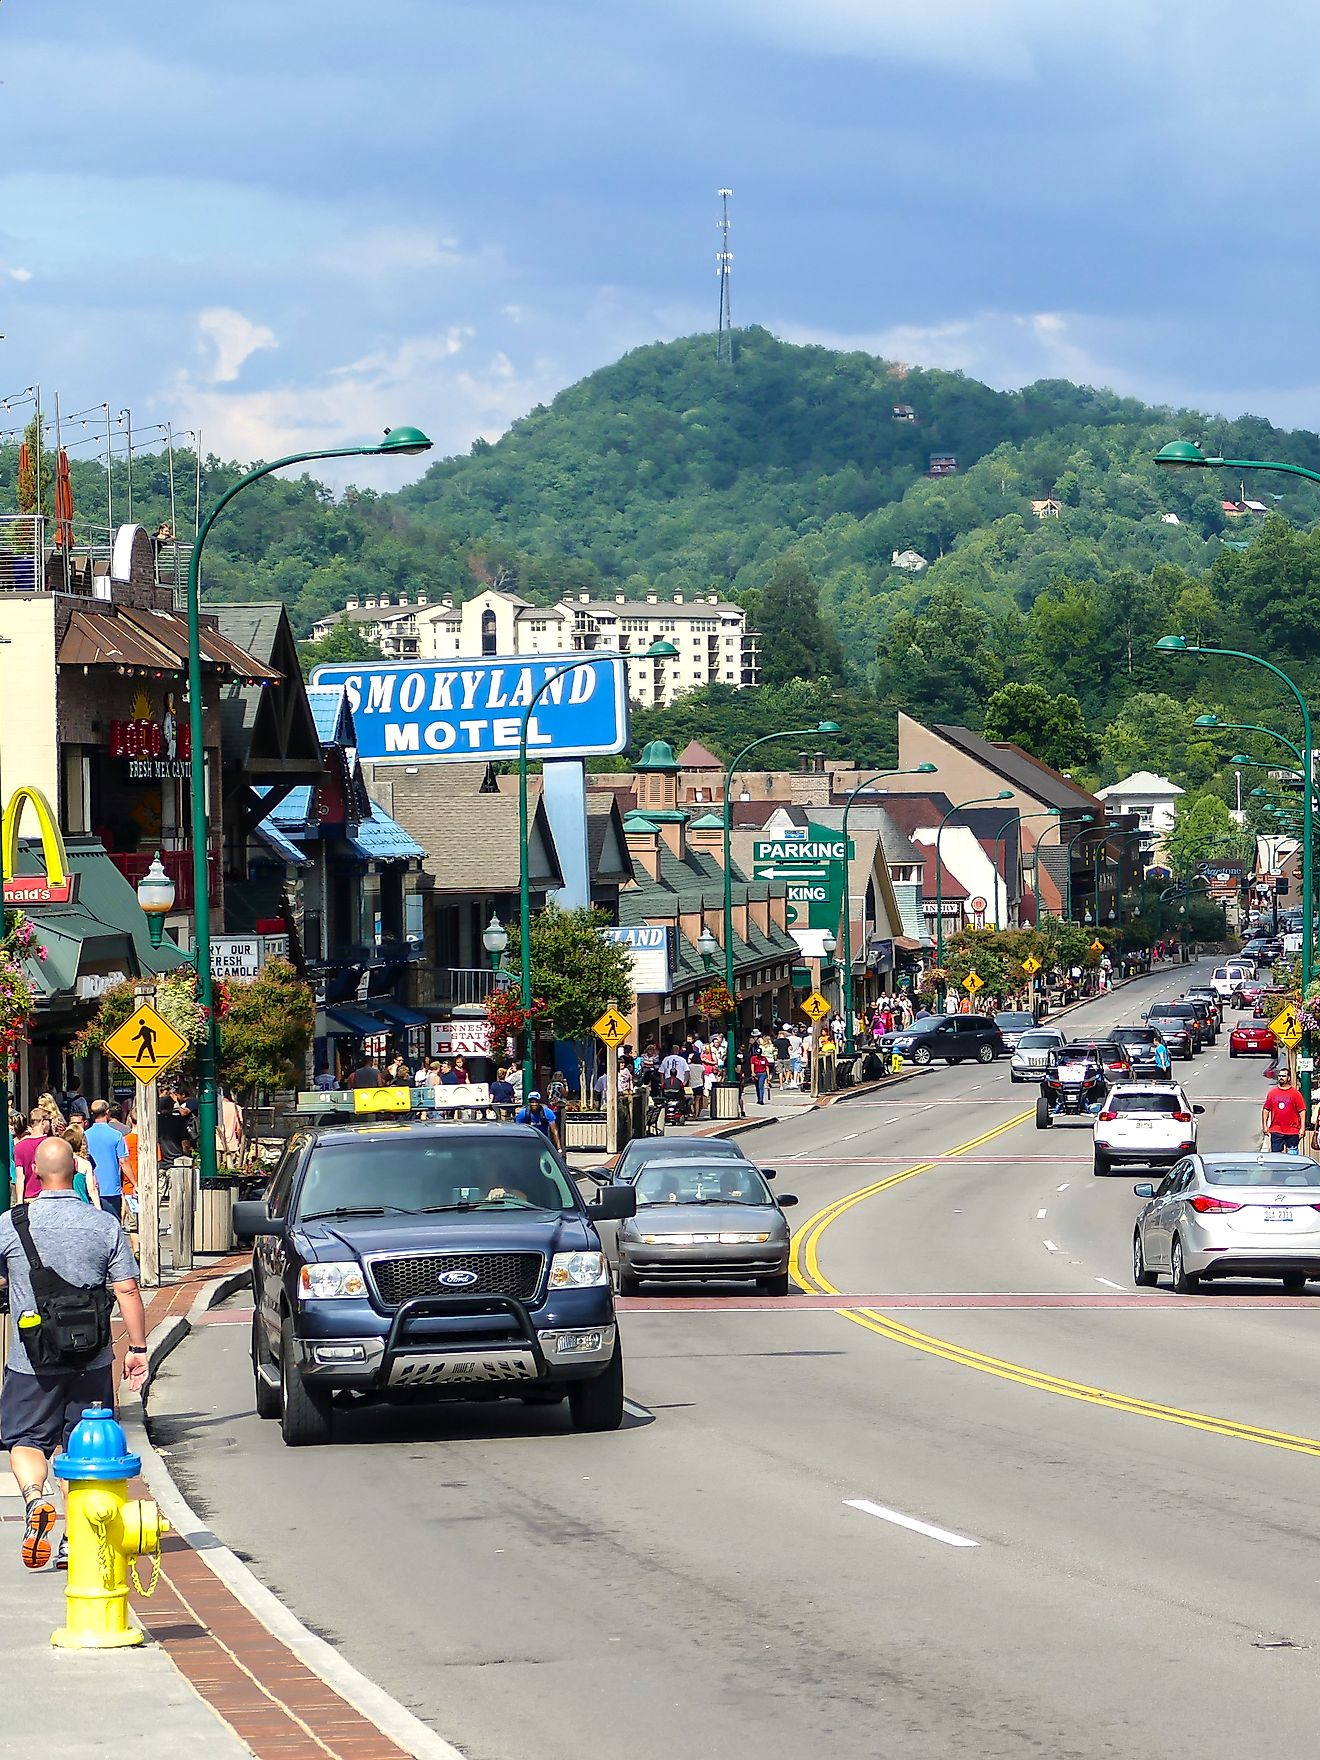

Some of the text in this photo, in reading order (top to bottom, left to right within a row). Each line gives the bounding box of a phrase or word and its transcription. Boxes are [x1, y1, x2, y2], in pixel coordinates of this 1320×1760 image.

[343, 664, 597, 715] SMOKYLAND
[384, 716, 552, 752] MOTEL
[129, 761, 152, 778] FRESH
[155, 761, 170, 778] MEX
[759, 842, 845, 858] PARKING
[231, 945, 251, 954] OUR
[445, 1272, 469, 1283] Ford
